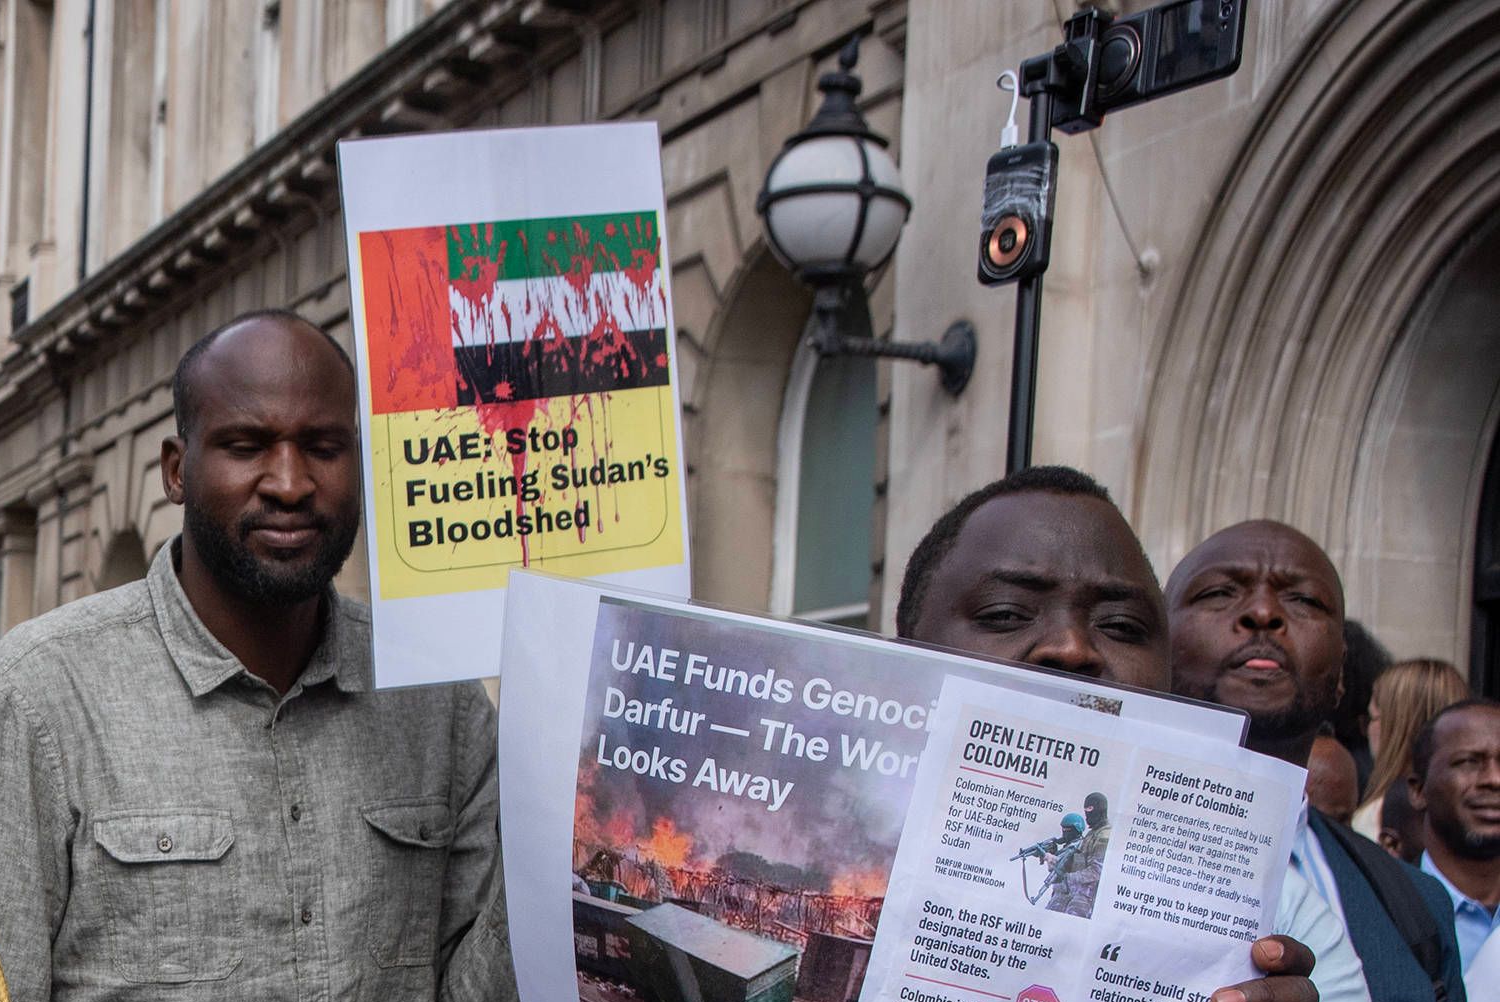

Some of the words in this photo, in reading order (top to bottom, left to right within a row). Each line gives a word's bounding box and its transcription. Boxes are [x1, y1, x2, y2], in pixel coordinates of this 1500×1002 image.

[402, 432, 492, 466] UAE:
[505, 425, 579, 457] Stop
[405, 468, 541, 507] Fueling
[408, 501, 591, 548] Bloodshed
[610, 638, 680, 682] UAE
[683, 653, 794, 704] Funds
[603, 686, 706, 737] Darfur
[759, 717, 830, 763] The
[970, 720, 1014, 746] OPEN
[1016, 731, 1075, 761] LETTER
[1080, 746, 1099, 766] TO
[597, 733, 688, 784] Looks
[692, 757, 795, 812] Away
[963, 743, 1047, 779] COLOMBIA
[955, 777, 1004, 798] Colombian
[1006, 789, 1063, 812] Mercenaries
[1141, 781, 1179, 801] People
[1181, 793, 1194, 804] of
[1195, 794, 1248, 818] Colombia:
[1146, 765, 1201, 789] President
[1202, 779, 1232, 796] Petro
[1234, 790, 1254, 802] and
[948, 805, 962, 817] for
[964, 809, 1020, 831] UAE-Backed
[952, 791, 975, 805] Must
[976, 797, 998, 812] Stop
[999, 802, 1037, 822] Fighting
[1137, 803, 1155, 819] Your
[1156, 810, 1210, 831] mercenaries,
[1212, 824, 1248, 839] recruited
[1249, 831, 1258, 843] by
[941, 833, 970, 849] Sudan
[945, 819, 963, 832] RSF
[964, 824, 992, 840] Militia
[994, 831, 1003, 842] in
[1132, 817, 1158, 831] rulers,
[1160, 824, 1175, 833] are
[1176, 826, 1200, 841] being
[1202, 834, 1223, 845] used
[1223, 839, 1233, 848] as
[1234, 842, 1258, 855] pawns
[1138, 831, 1144, 839] a
[1145, 833, 1187, 849] genocidal
[1189, 843, 1205, 853] war
[1206, 848, 1237, 861] against
[1238, 854, 1250, 865] the
[935, 865, 947, 875] THE
[948, 868, 972, 880] UNITED
[972, 874, 1004, 888] KINGDOM
[936, 856, 962, 869] DARFUR
[963, 863, 983, 874] UNION
[984, 868, 992, 876] IN
[1123, 854, 1137, 863] not
[1139, 856, 1164, 872] aiding
[1166, 864, 1215, 884] peace–they
[1216, 876, 1231, 886] are
[1125, 841, 1154, 854] people
[1155, 847, 1165, 857] of
[1165, 849, 1194, 864] Sudan.
[1197, 856, 1221, 870] These
[1223, 865, 1241, 875] men
[1242, 870, 1254, 879] are
[1121, 864, 1146, 879] killing
[1147, 871, 1180, 886] civilians
[1182, 881, 1207, 893] under
[1207, 886, 1213, 894] a
[1215, 887, 1241, 903] deadly
[923, 900, 954, 920] Soon,
[958, 909, 977, 923] the
[979, 913, 1003, 929] RSF
[1005, 921, 1026, 935] will
[1027, 924, 1041, 939] be
[1113, 901, 1137, 914] away
[1140, 905, 1161, 919] from
[1163, 911, 1180, 923] this
[1181, 917, 1228, 935] murderous
[1117, 885, 1131, 897] We
[1133, 891, 1154, 904] urge
[1156, 897, 1173, 907] you
[1175, 900, 1185, 910] to
[1187, 902, 1208, 918] keep
[1210, 910, 1231, 922] your
[1232, 916, 1258, 930] people
[914, 935, 987, 960] organisation
[990, 950, 1005, 966] by
[1007, 955, 1026, 969] the
[919, 917, 983, 942] designated
[984, 934, 998, 946] as
[1000, 939, 1008, 948] a
[1011, 939, 1053, 958] terrorist
[910, 949, 949, 968] United
[949, 958, 989, 979] States.
[1095, 967, 1151, 991] Countries
[1152, 981, 1185, 1000] build
